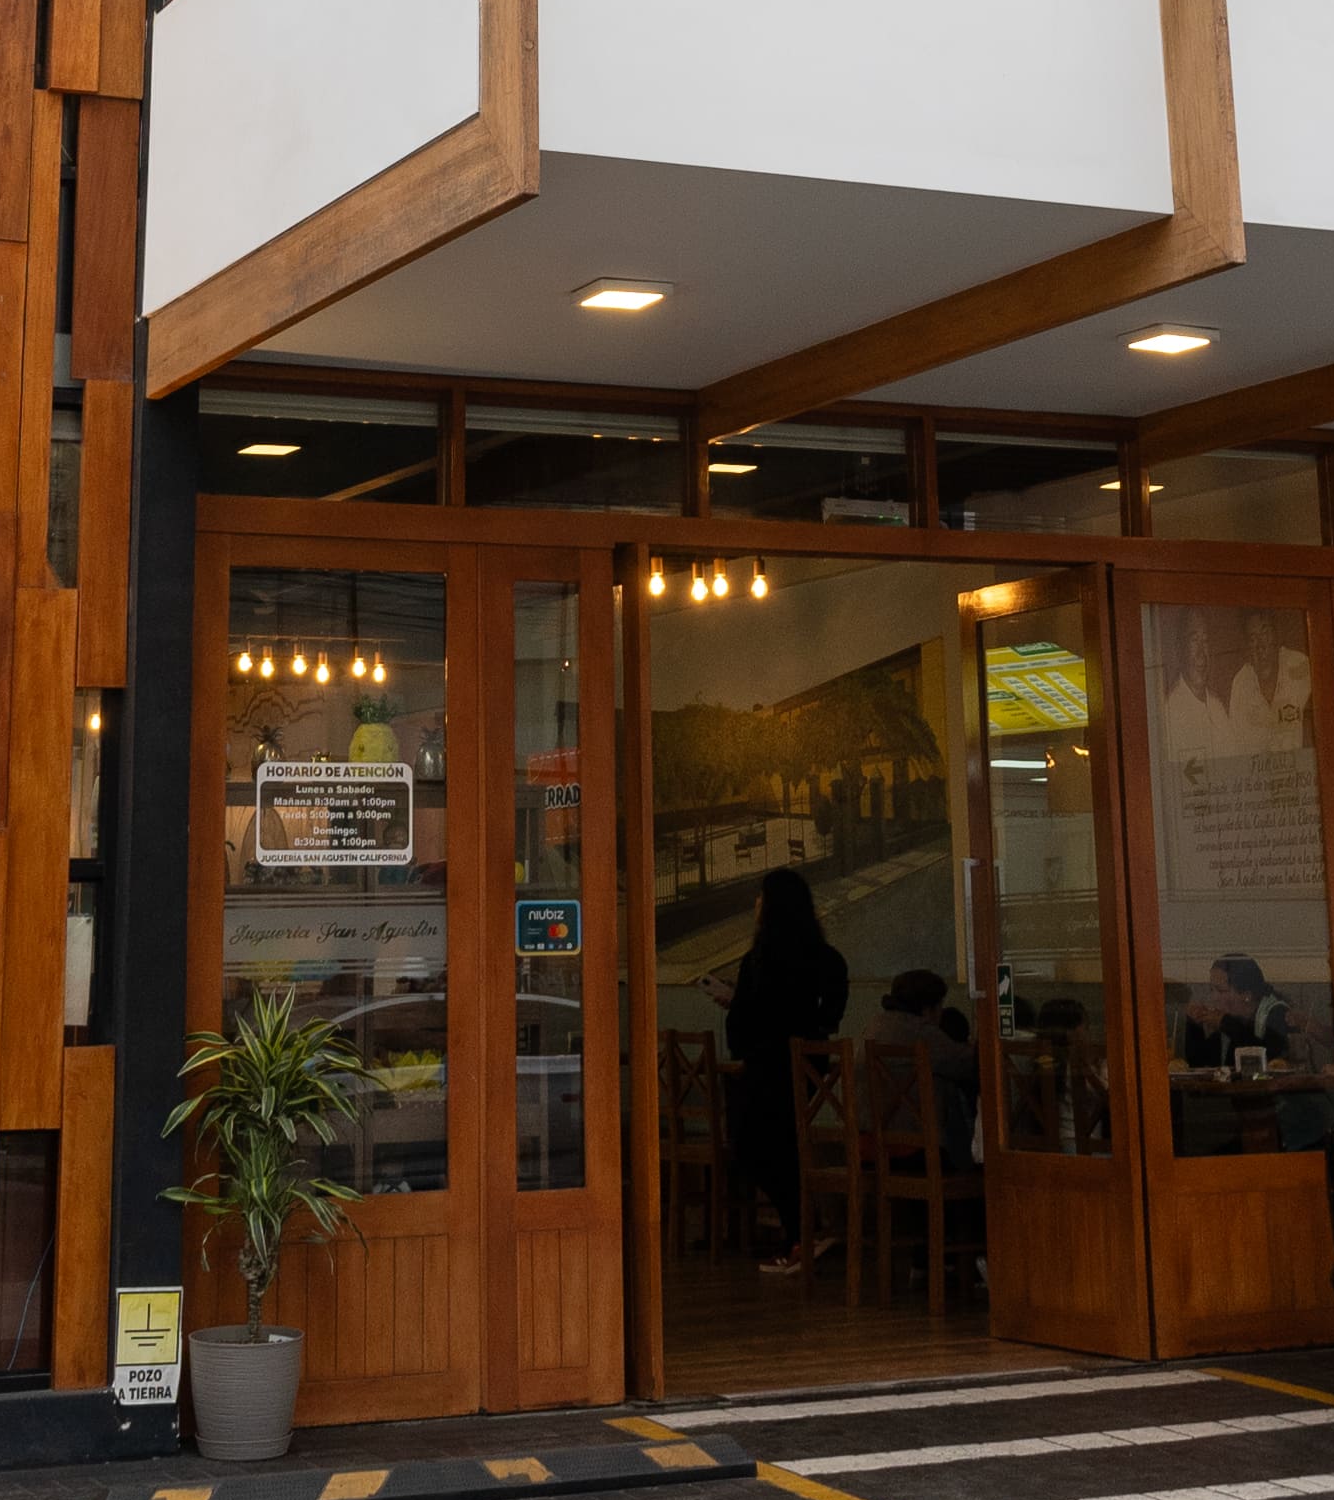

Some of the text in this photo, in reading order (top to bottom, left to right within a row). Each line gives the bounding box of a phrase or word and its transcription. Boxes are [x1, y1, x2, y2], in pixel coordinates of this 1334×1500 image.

[266, 764, 404, 777] HORARIO DE ATENCIÓN
[295, 785, 325, 794] Lunes
[274, 797, 312, 807] Mañana
[352, 799, 358, 807] a
[361, 797, 396, 809] 1:00pm
[356, 810, 391, 821] 9:00pm
[313, 826, 358, 837] Domingo:
[341, 838, 377, 849] 1:00pm
[303, 854, 321, 862] SAN
[359, 853, 408, 862] CALIFORNIA
[528, 909, 565, 920] niubiz
[129, 1369, 163, 1383] POZO
[118, 1386, 173, 1400] A TIERRA
